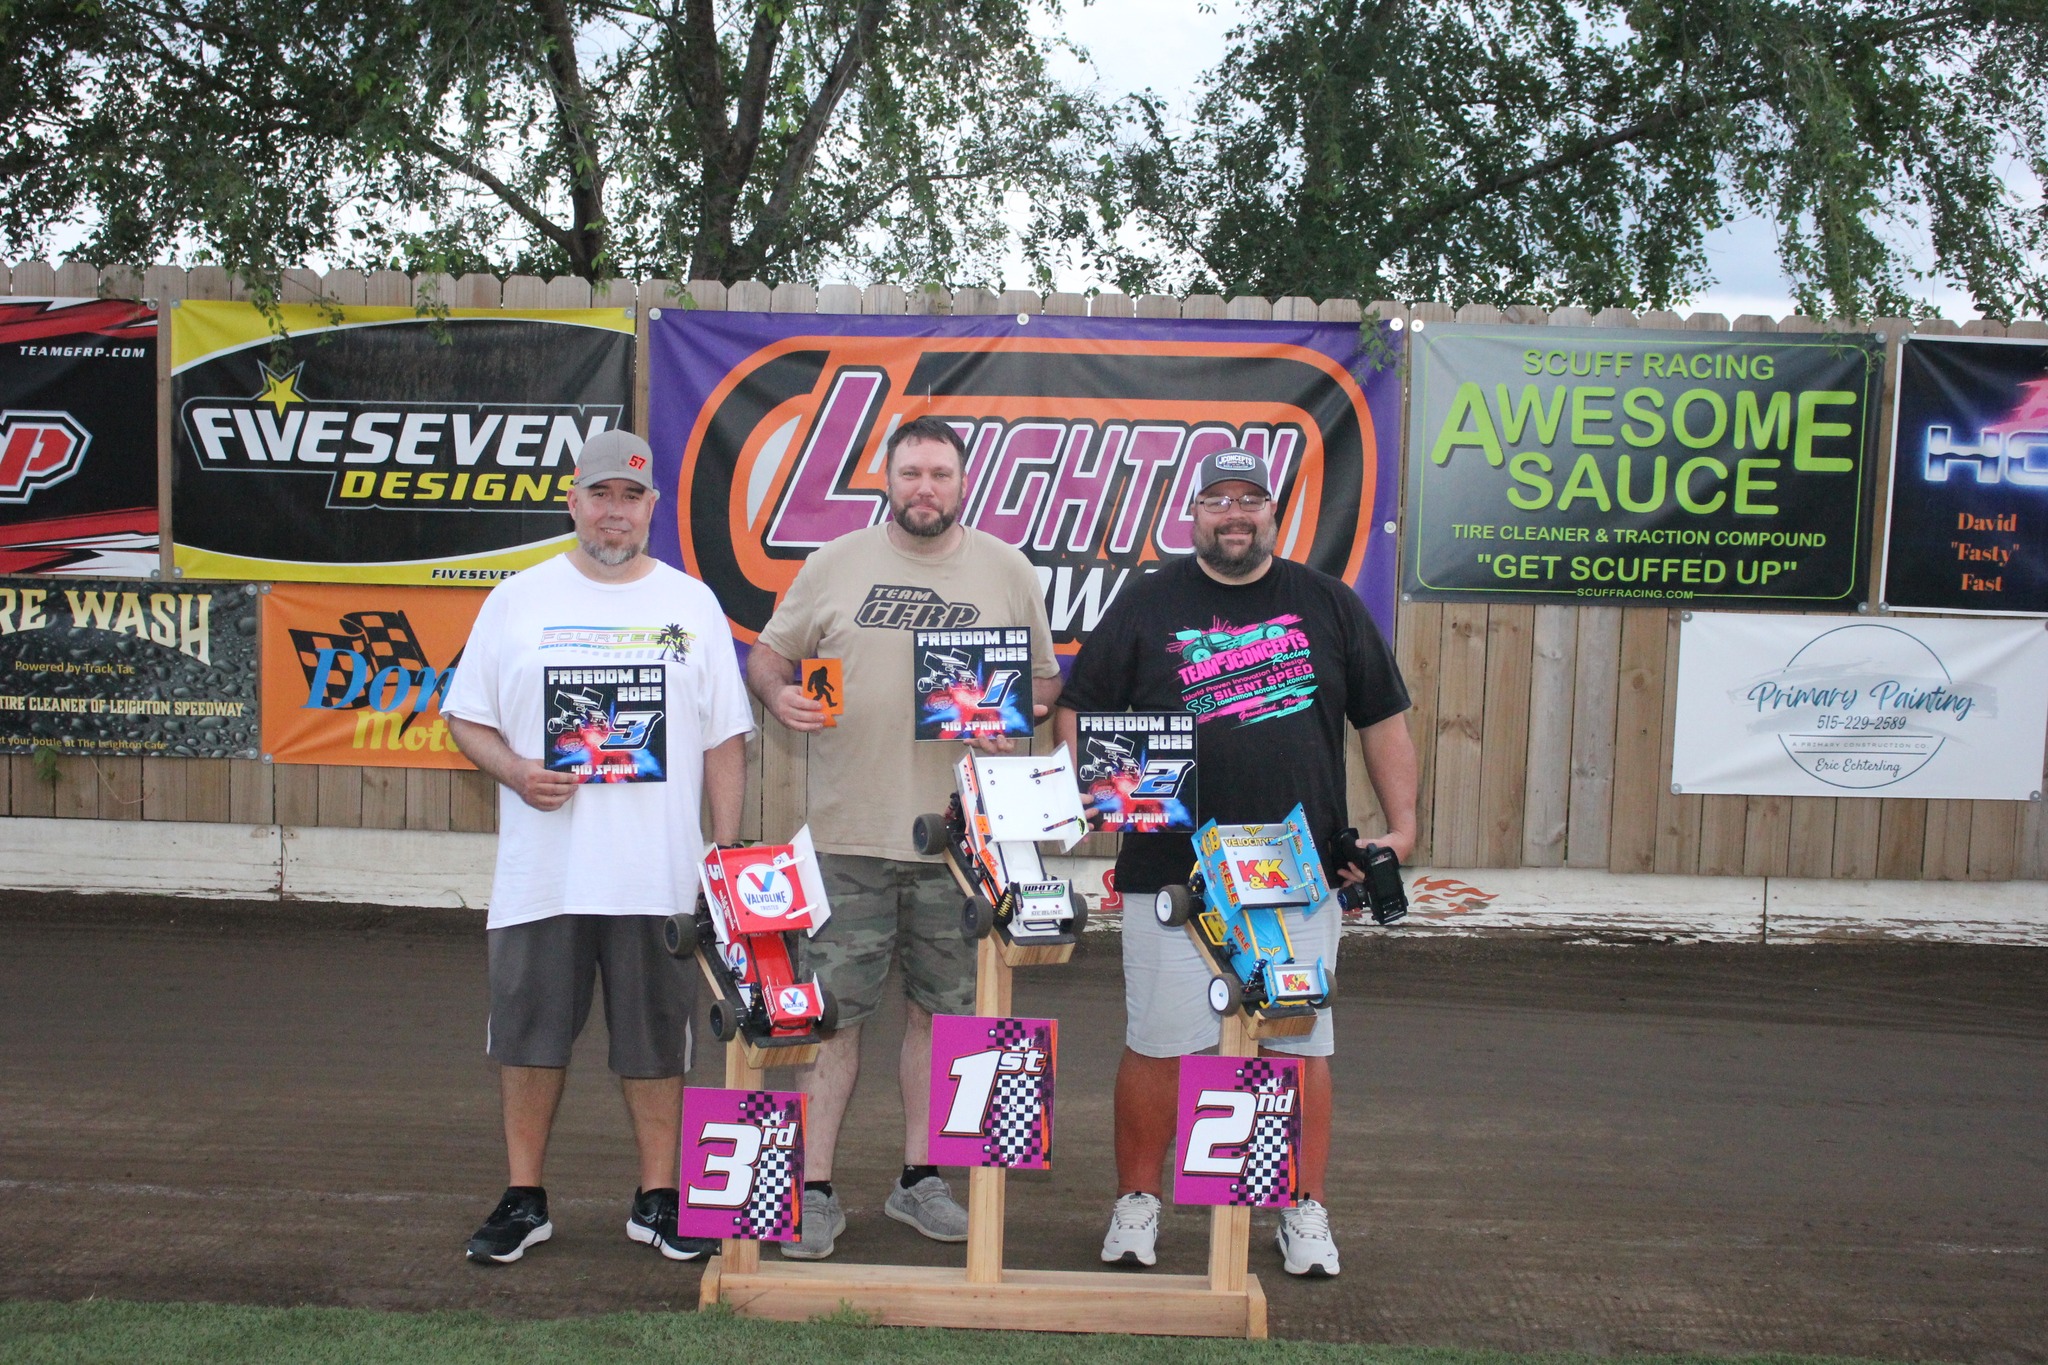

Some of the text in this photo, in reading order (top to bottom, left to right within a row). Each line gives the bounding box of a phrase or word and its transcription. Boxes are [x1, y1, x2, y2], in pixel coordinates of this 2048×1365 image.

[19, 345, 146, 359] TEAMGFRP.COM
[1522, 349, 1775, 380] SCUFF RACING
[1430, 381, 1857, 472] AWESOME
[192, 407, 608, 467] FIVESEVEN
[628, 454, 647, 470] 57
[766, 370, 1298, 555] LIGHTON
[1219, 455, 1252, 464] JCONCEPTS
[1506, 451, 1781, 515] SAUCE
[1957, 512, 2017, 533] David
[1452, 524, 1827, 548] TIRE CLEANER & TRACTION COMPOUND
[1951, 541, 2020, 566] "Fasty"
[1476, 553, 1797, 586] "GET SCUFFED UP"
[1961, 573, 2003, 592] Fast
[874, 587, 932, 601] TEAM
[1576, 587, 1694, 600] SCUFFRACING.COM
[857, 602, 980, 630] GFRP
[64, 590, 212, 667] WASH
[917, 631, 1000, 646] FREEDOM
[984, 647, 1028, 662] 2025
[1178, 631, 1310, 685] TEAM JCONCEPTS
[1272, 648, 1311, 664] Racing
[15, 661, 135, 675] Powered by Track Tac
[548, 668, 634, 685] FREEDOM
[1182, 689, 1205, 702] World
[1206, 682, 1231, 693] Proven
[1232, 669, 1270, 685] Innovation
[1281, 657, 1307, 670] Design
[1214, 663, 1313, 700] SILENT SPEED
[617, 686, 662, 702] 2025
[1217, 673, 1315, 706] COMPETITION MOTORS by JCONCEPTS
[29, 697, 87, 713] CLEANER
[91, 699, 106, 713] OF
[110, 700, 170, 715] LEIGHTON
[174, 702, 244, 717] SPEEDWAY
[1281, 695, 1308, 709] Florida
[1747, 681, 1976, 721] Primary Painting
[598, 710, 664, 751] 3
[941, 720, 1007, 731] 410 SPRINT
[1080, 716, 1165, 731] FREEDOM
[1816, 715, 1907, 731] 515-229-2589
[8, 737, 30, 747] your
[33, 737, 62, 747] bottle
[65, 739, 75, 748] at
[78, 739, 95, 748] The
[98, 740, 141, 751] Leighton
[144, 741, 167, 750] Cafe
[1148, 734, 1193, 750] 2025
[571, 763, 640, 776] 410 SPRINT
[1815, 758, 1840, 772] Eric
[1129, 759, 1196, 799] 2
[1103, 812, 1171, 823] 410 SPRINT
[707, 863, 723, 881] 5
[744, 890, 788, 905] VALVOLINE
[939, 1047, 1048, 1137] 1st
[1182, 1086, 1298, 1177] 2nd
[686, 1120, 800, 1209] 3rd
